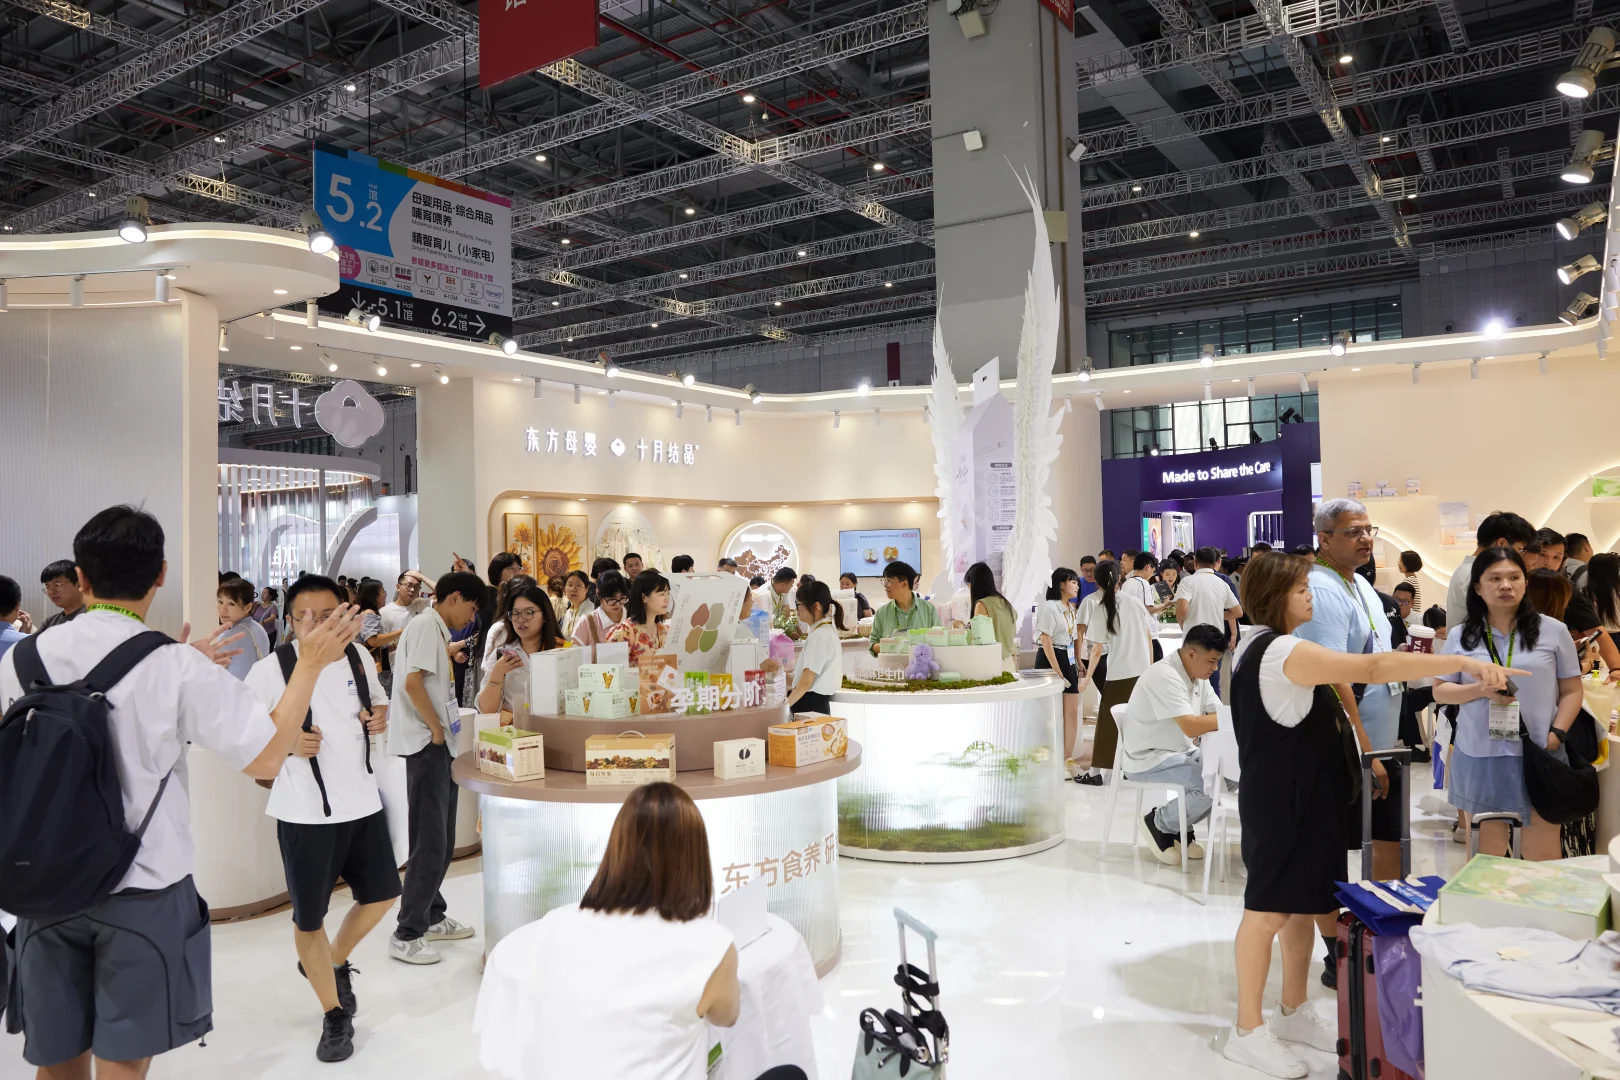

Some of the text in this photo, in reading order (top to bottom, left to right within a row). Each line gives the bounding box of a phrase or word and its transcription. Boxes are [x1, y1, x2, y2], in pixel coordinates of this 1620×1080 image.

[326, 173, 383, 232] 5.2
[368, 189, 378, 201] 馆
[411, 191, 494, 225] 母婴用品·综合用品
[411, 206, 453, 227] 哺育喂养
[411, 244, 426, 253] Smart
[426, 247, 447, 259] Parenting
[377, 298, 401, 319] 5.1
[402, 301, 414, 309] Hall
[403, 309, 414, 321] 馆
[431, 308, 458, 329] 6.2
[458, 319, 468, 332] 馆
[525, 426, 695, 465] 东方母婴 十月结晶
[1162, 461, 1271, 484] Made to Share the Care
[91, 604, 130, 615] MATERNITY
[721, 832, 839, 895] 东方食养研
